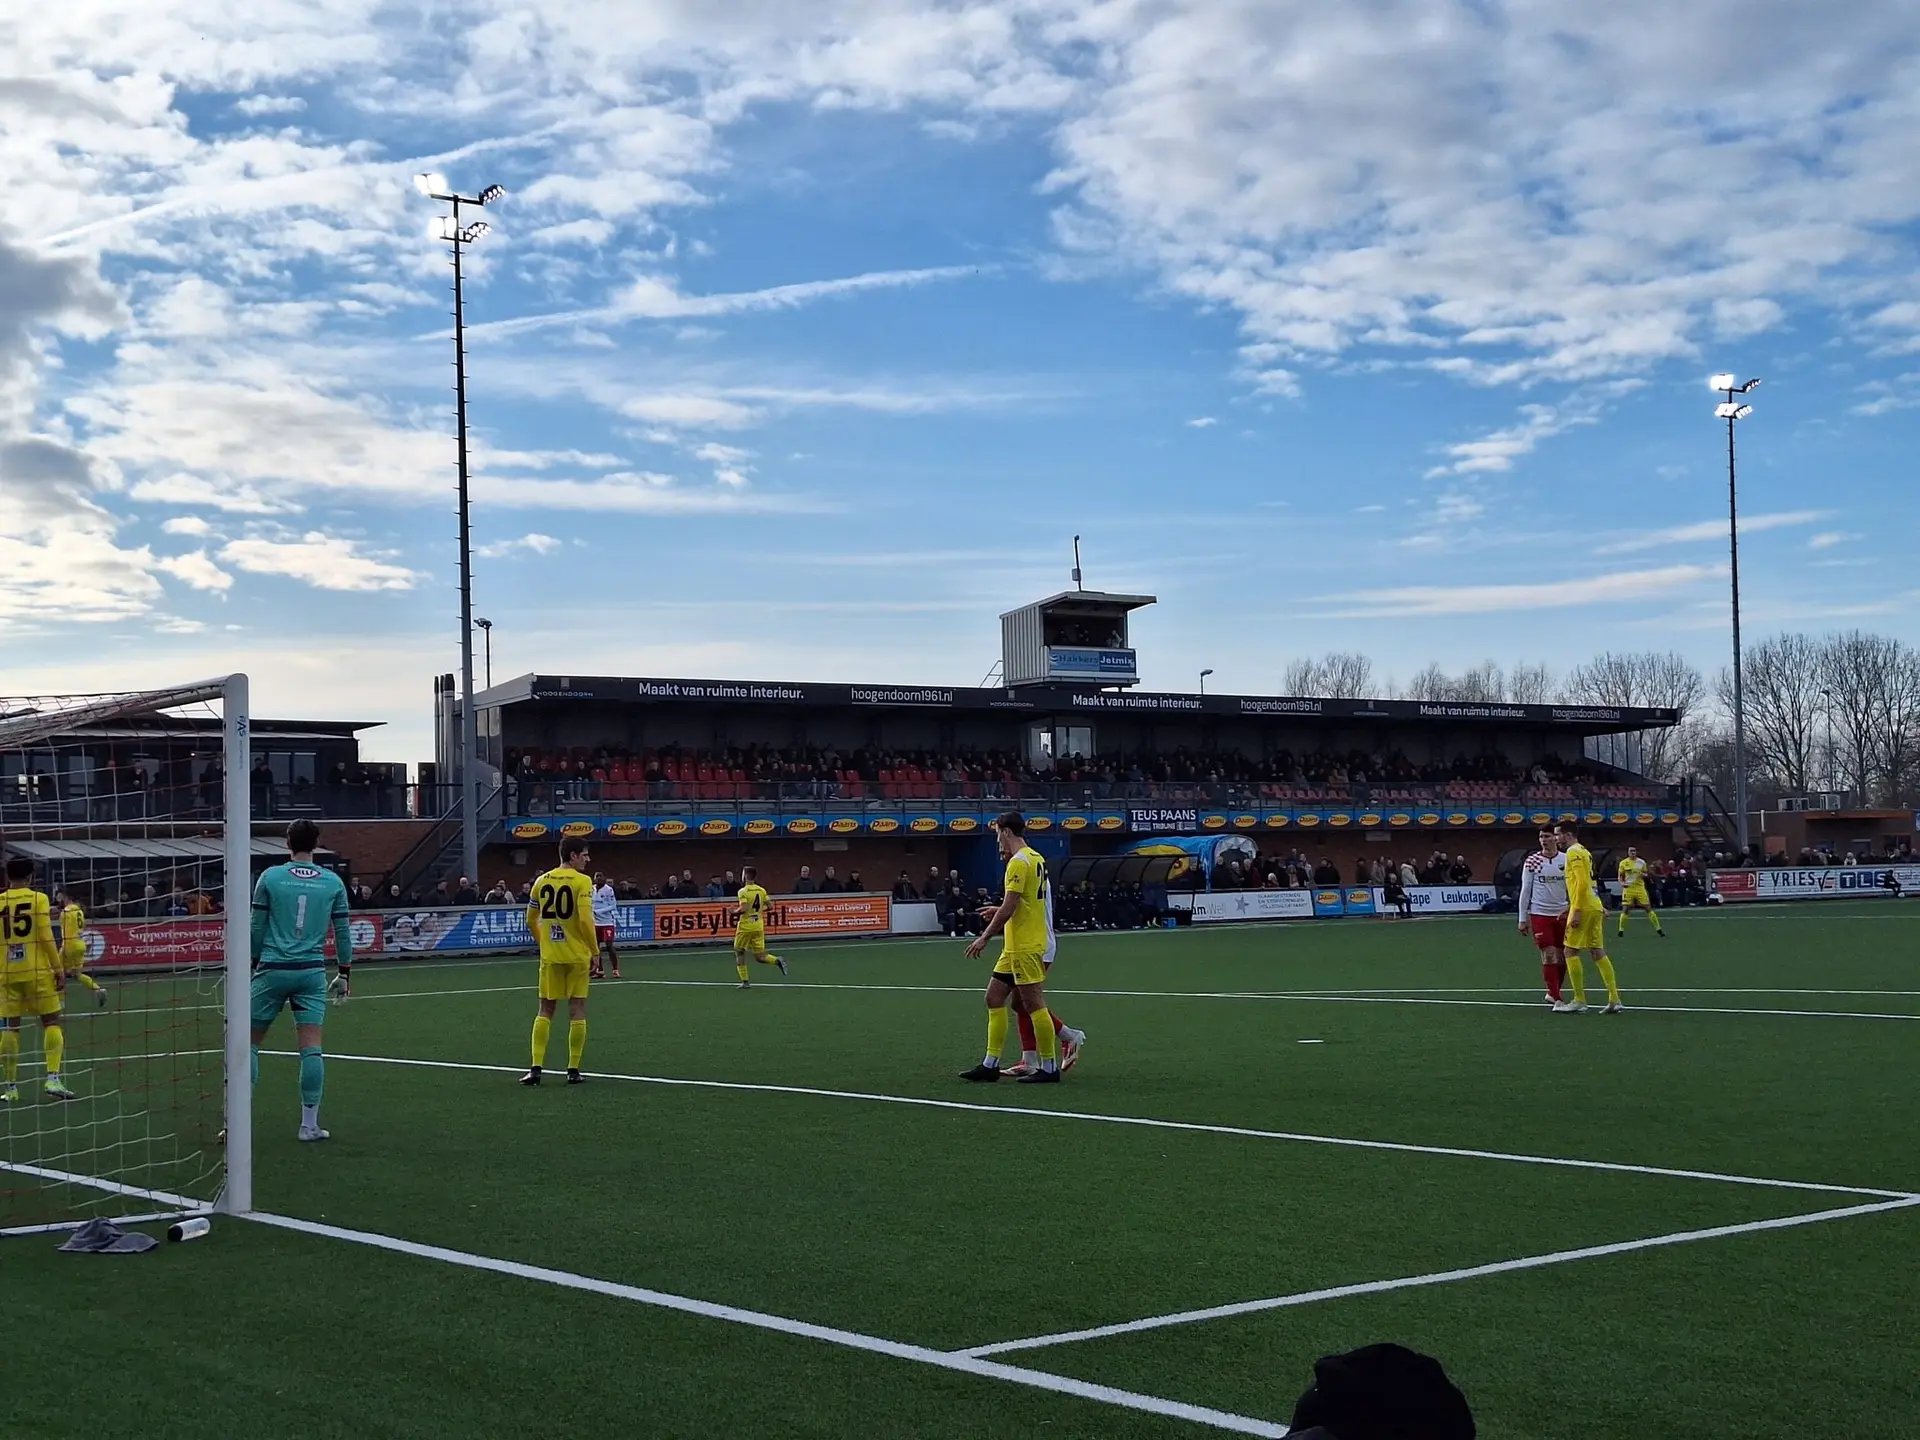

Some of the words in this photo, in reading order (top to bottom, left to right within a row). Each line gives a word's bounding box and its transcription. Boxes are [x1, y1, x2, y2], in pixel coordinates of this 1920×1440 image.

[639, 682, 680, 696] Maakt
[682, 686, 705, 697] van
[707, 685, 748, 698] ruimte
[750, 685, 804, 699] interieur.
[851, 687, 953, 703] hoogendoorn1961.nl
[1073, 694, 1104, 707] Maakt
[1106, 698, 1124, 708] van
[1126, 697, 1158, 708] ruimte
[1160, 697, 1202, 710] interieur.
[1241, 699, 1322, 713] hoogendoorn1961.nl
[1420, 705, 1446, 716] Maakt
[1447, 707, 1462, 716] van
[1463, 706, 1490, 717] ruimte
[1491, 706, 1526, 718] interieur.
[1131, 809, 1159, 822] TEUS
[1161, 809, 1197, 822] PAANS
[562, 824, 593, 835] Paans
[609, 823, 639, 834] Paans
[655, 822, 685, 833] Paans
[702, 821, 730, 833] Paans
[745, 821, 774, 832] Paans
[788, 820, 816, 831] Paans
[830, 820, 858, 831] Paans
[872, 820, 899, 831] Paans
[912, 819, 938, 830] Paans
[951, 818, 977, 829] Paans
[514, 825, 545, 837] Paans
[1771, 871, 1815, 889] VRIES
[540, 884, 574, 920] 20
[751, 893, 762, 913] 4
[1441, 890, 1490, 905] Leukotape
[0, 902, 32, 940] 15
[295, 894, 308, 940] 1
[660, 905, 787, 938] gjstylenl
[128, 926, 226, 943] Supportersvereni
[469, 934, 507, 946] Samen
[111, 944, 132, 955] Van
